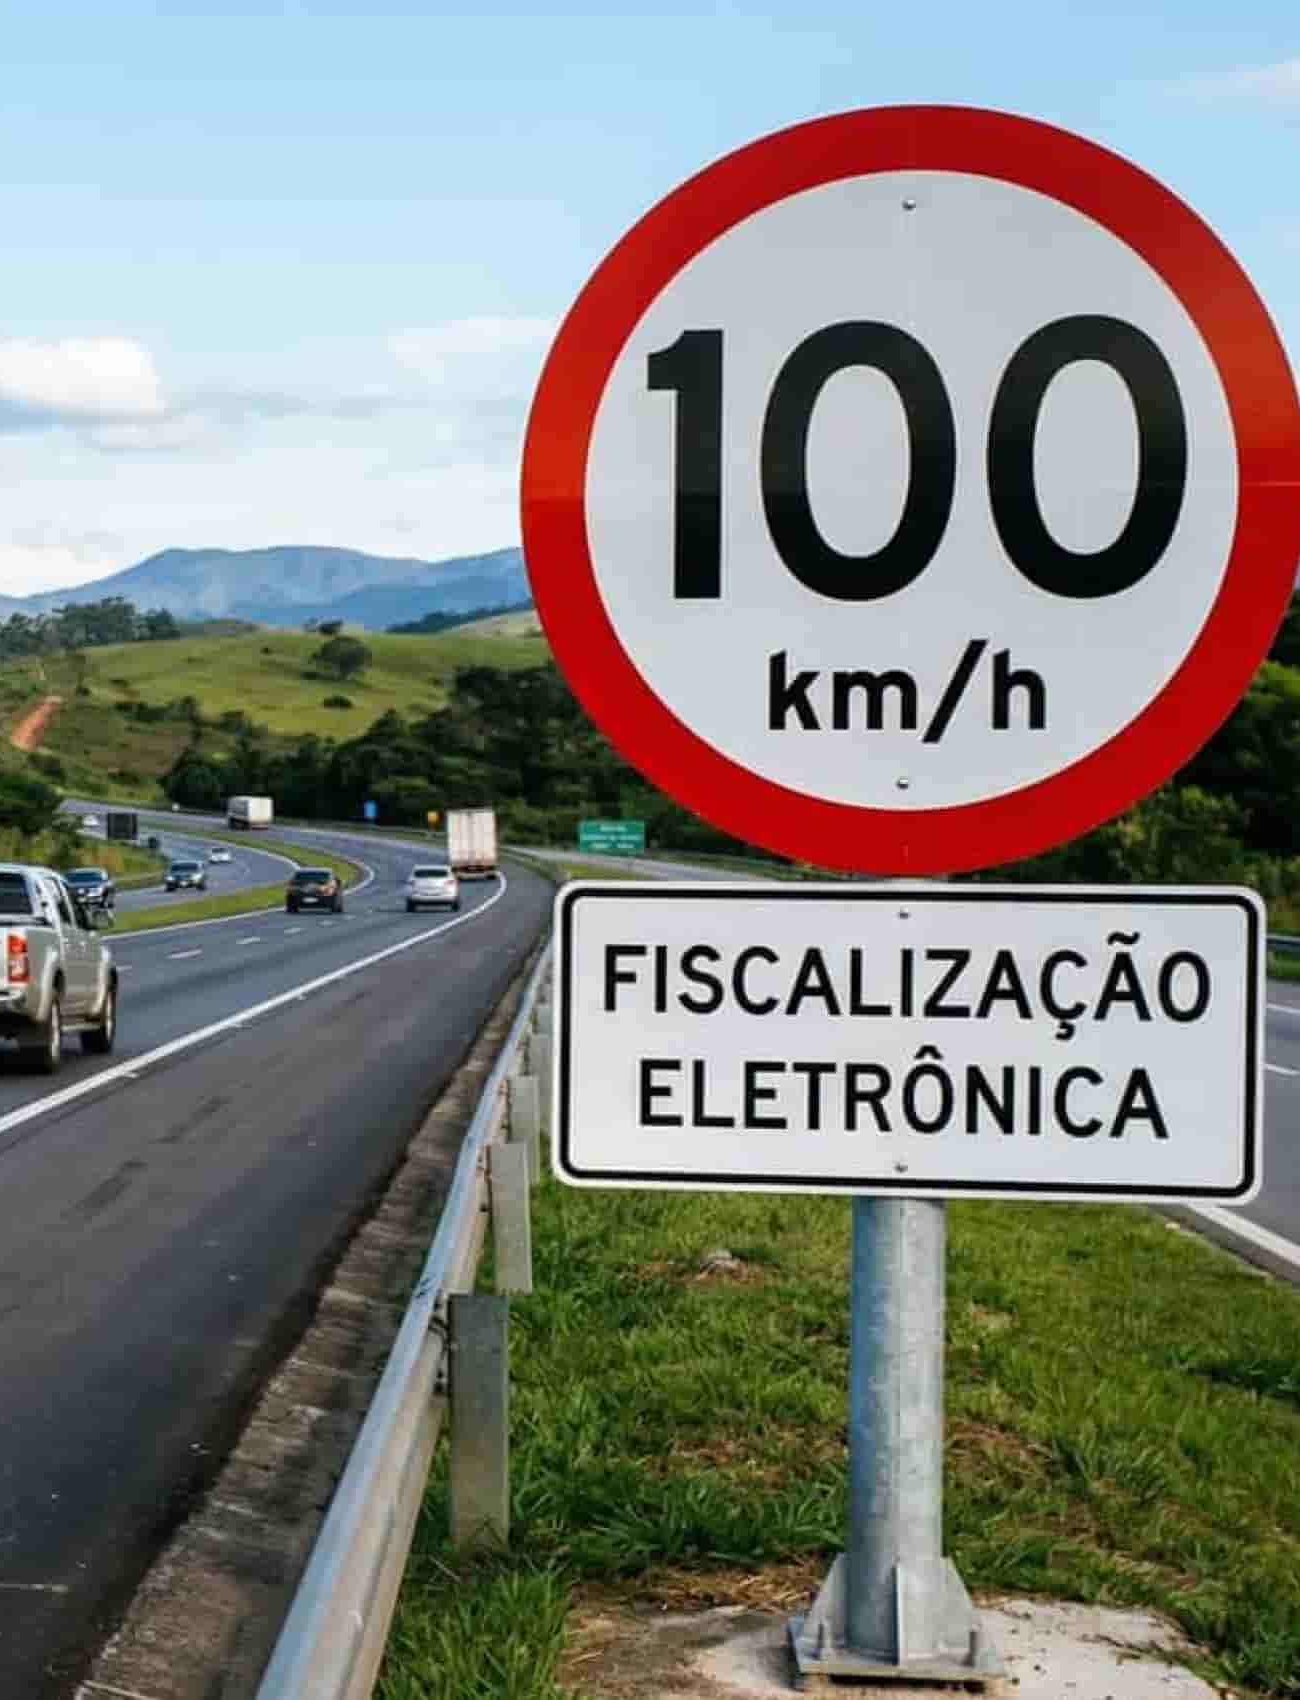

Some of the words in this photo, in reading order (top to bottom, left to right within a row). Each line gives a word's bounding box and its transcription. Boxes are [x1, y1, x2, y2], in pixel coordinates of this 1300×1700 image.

[646, 314, 1188, 602] 100
[768, 639, 1047, 744] km/h
[603, 931, 1211, 1041] FISCALIZAÇÃO
[639, 1045, 1170, 1139] ELETRÔNICA
